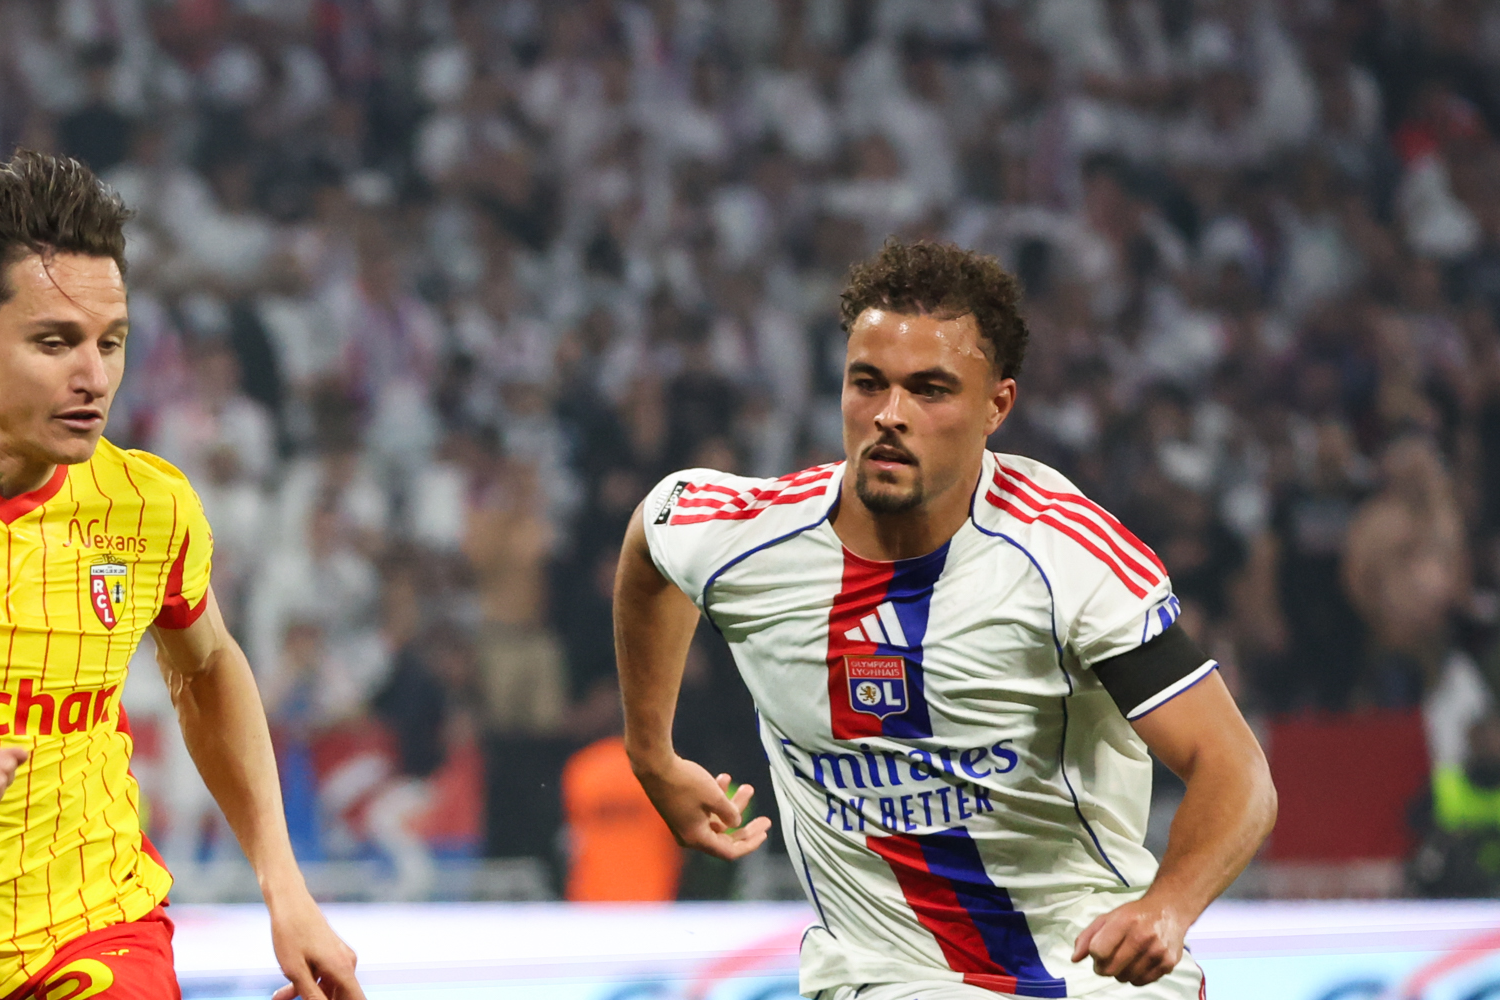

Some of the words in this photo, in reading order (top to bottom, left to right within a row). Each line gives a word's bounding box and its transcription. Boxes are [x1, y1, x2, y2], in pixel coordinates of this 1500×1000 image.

[62, 518, 148, 554] Nexans
[852, 668, 900, 676] LYONNAIS
[826, 793, 866, 832] FLY
[879, 782, 995, 832] BETTER
